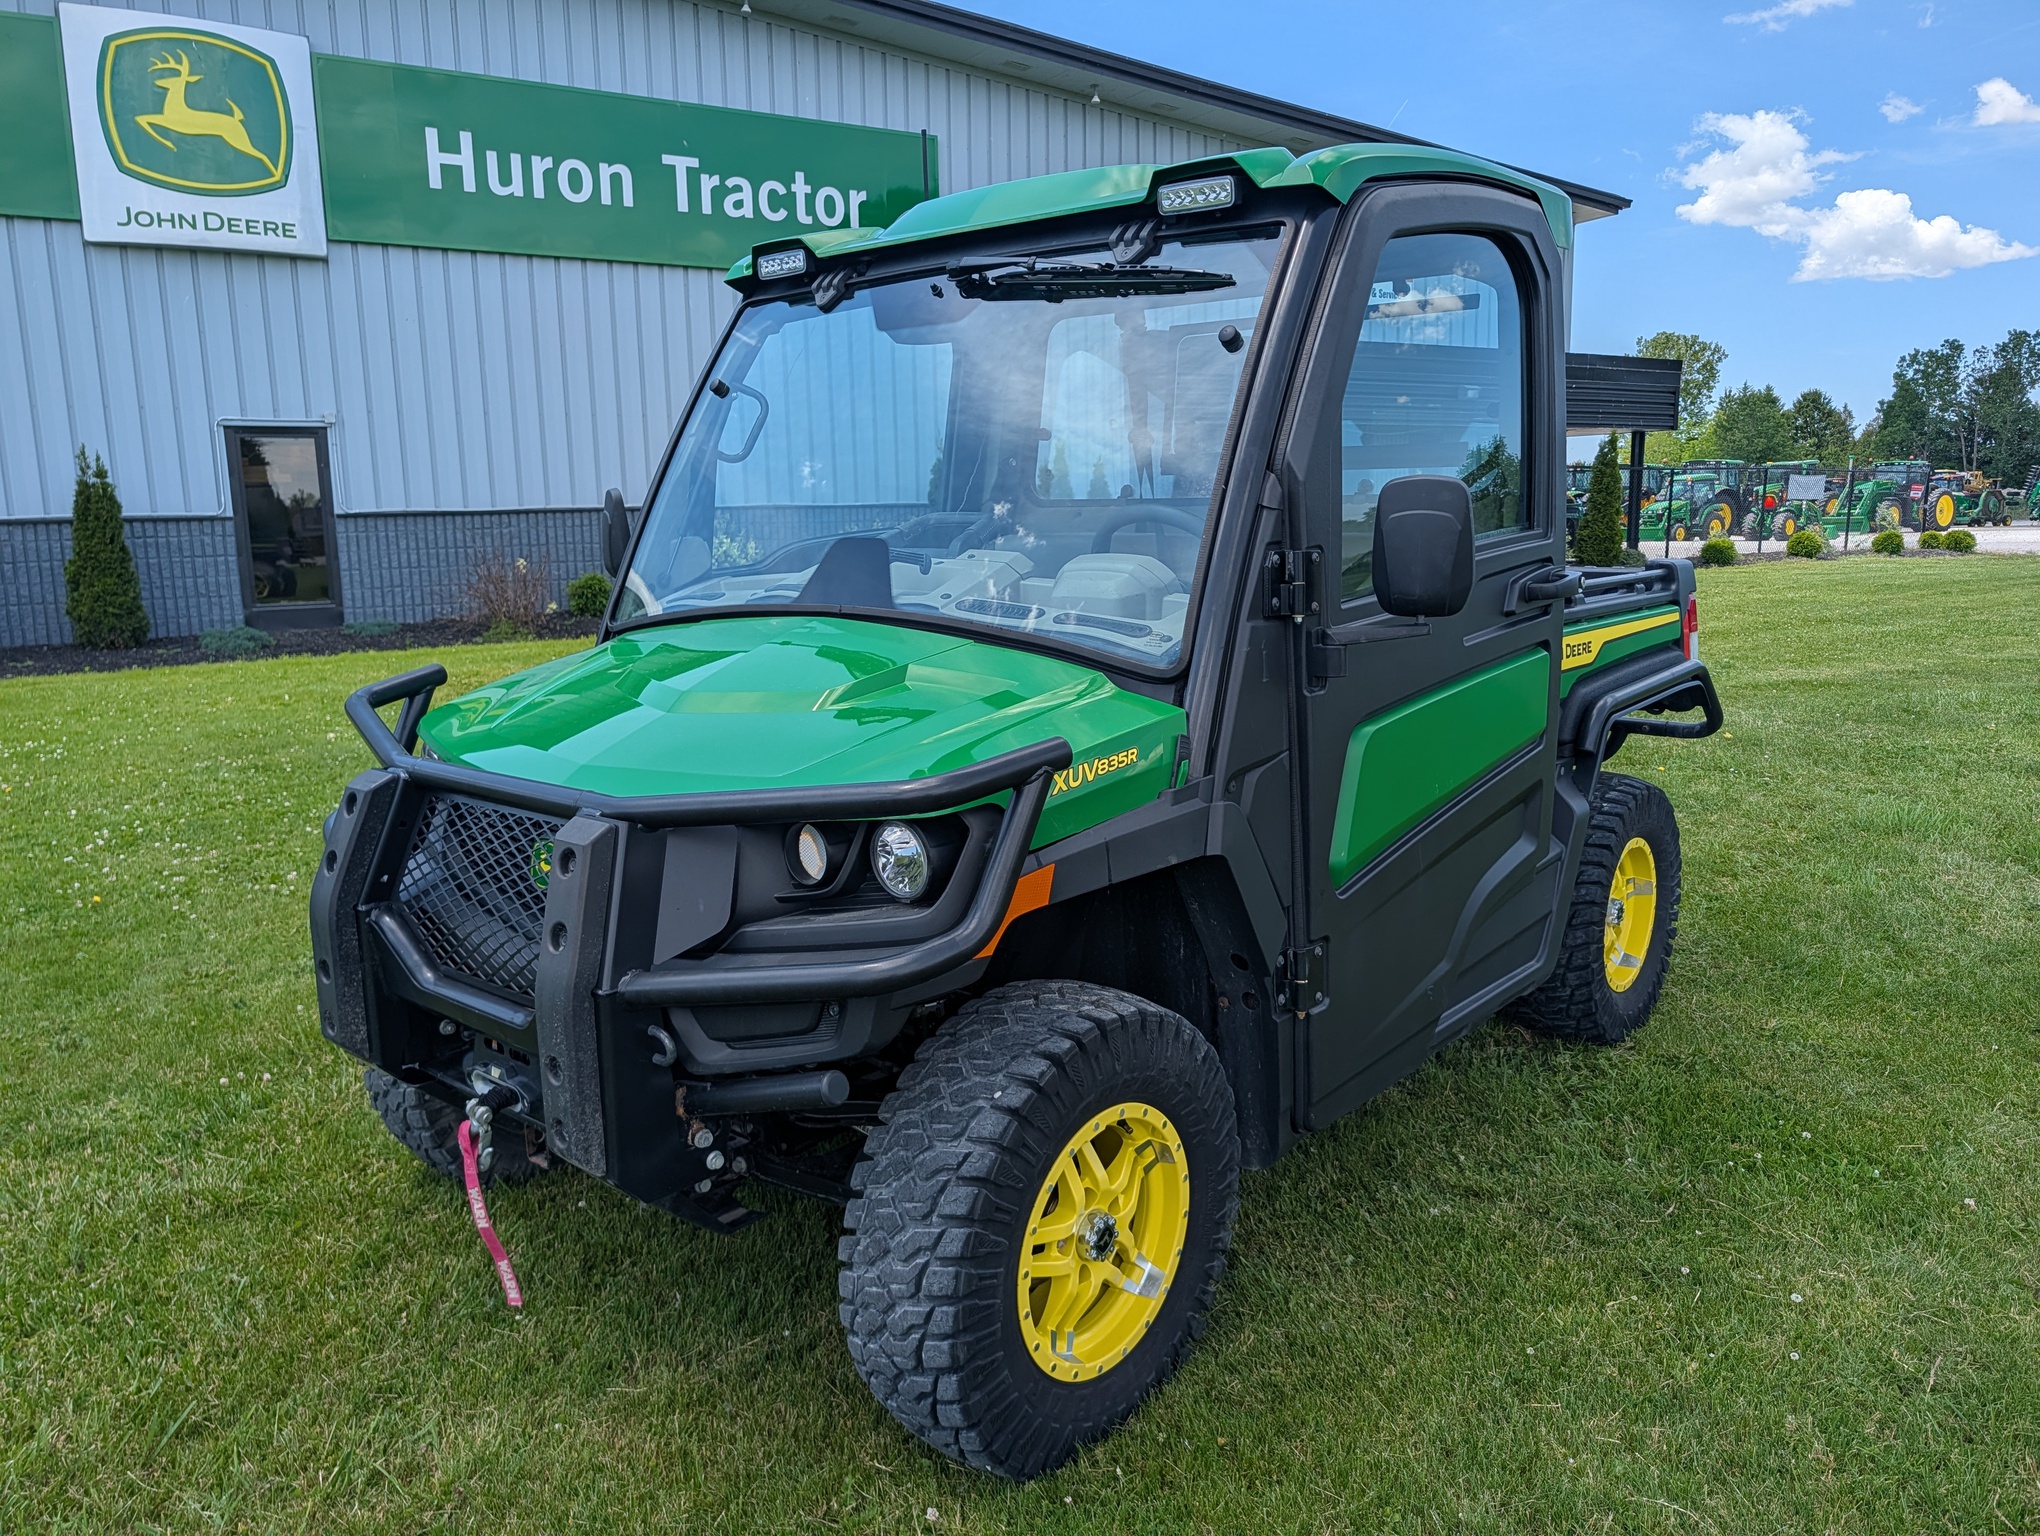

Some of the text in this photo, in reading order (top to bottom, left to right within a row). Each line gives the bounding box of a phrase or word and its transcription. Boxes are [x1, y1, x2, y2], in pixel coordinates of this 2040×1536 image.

[425, 126, 867, 229] Huron Tractor
[116, 206, 298, 239] JOHN DEERE
[1371, 287, 1401, 299] & Servic
[1565, 640, 1592, 660] DEERE
[1050, 746, 1138, 797] XUV835R
[468, 1187, 490, 1228] WARN
[497, 1259, 520, 1298] WARN
